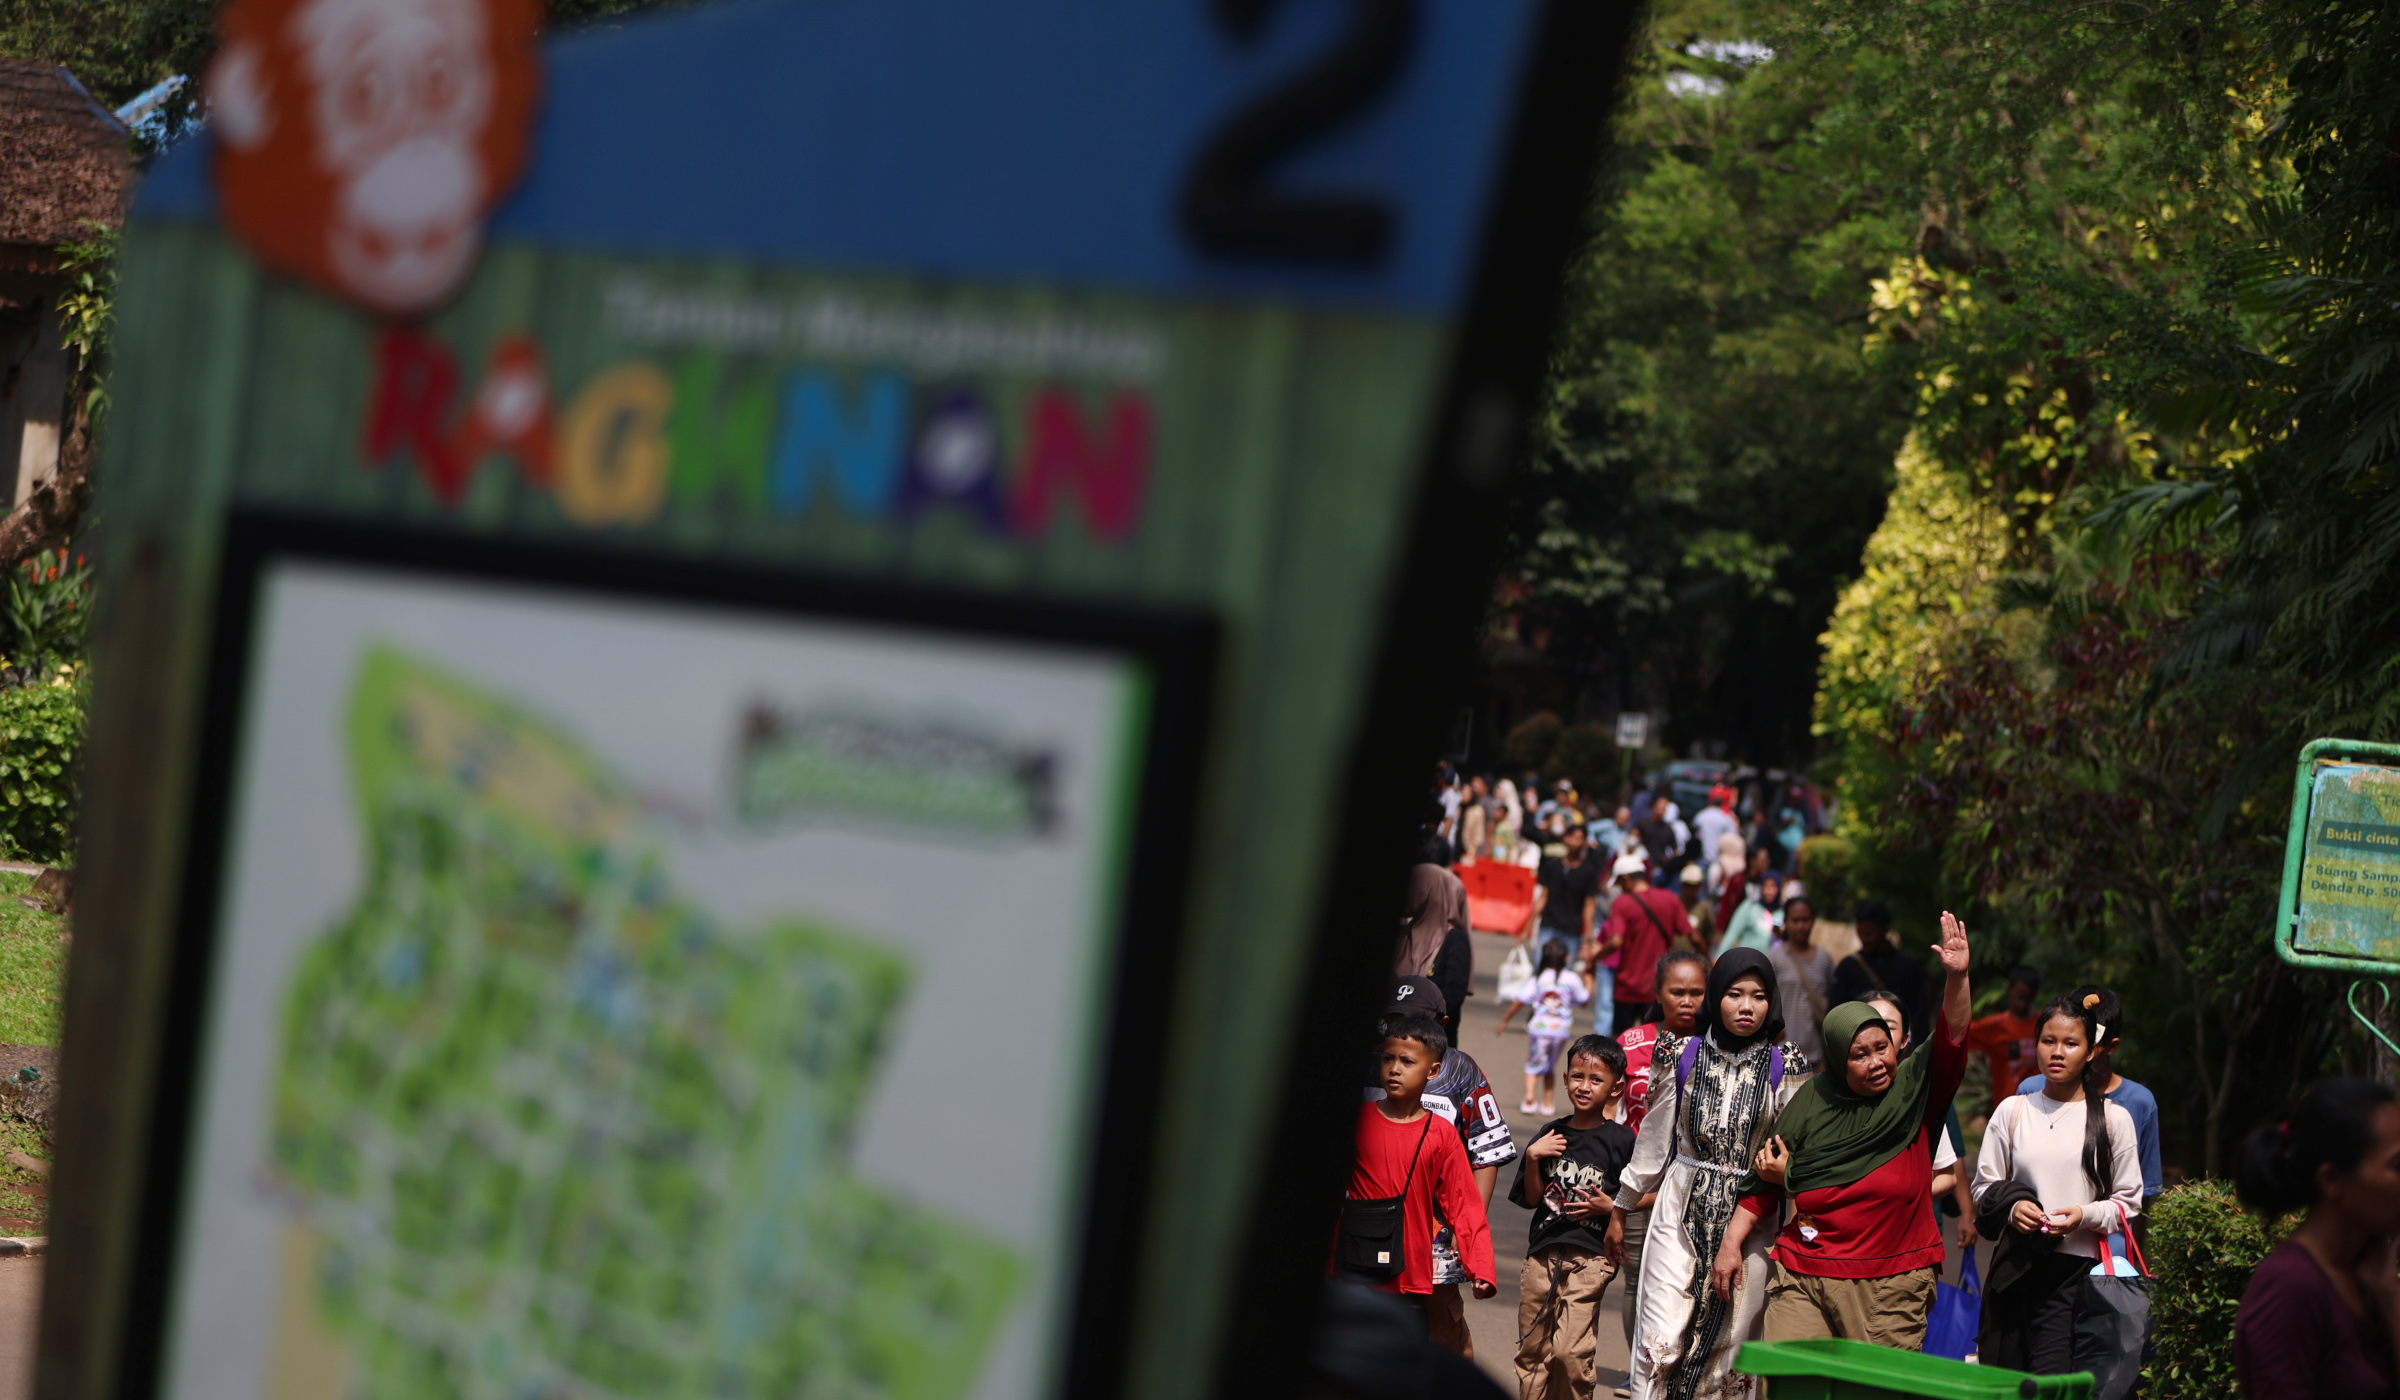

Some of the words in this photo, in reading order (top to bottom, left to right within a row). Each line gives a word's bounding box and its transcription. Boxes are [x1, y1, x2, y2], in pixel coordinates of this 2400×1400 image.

[2326, 827, 2363, 842] Bukti
[2365, 831, 2399, 846] cinta
[2316, 865, 2358, 880] Buang
[2362, 869, 2400, 884] Samp
[2311, 880, 2353, 893] Denda
[2357, 884, 2378, 897] Rp.
[2382, 887, 2400, 898] 50
[1396, 984, 1415, 1001] P
[1624, 1028, 1645, 1046] 23
